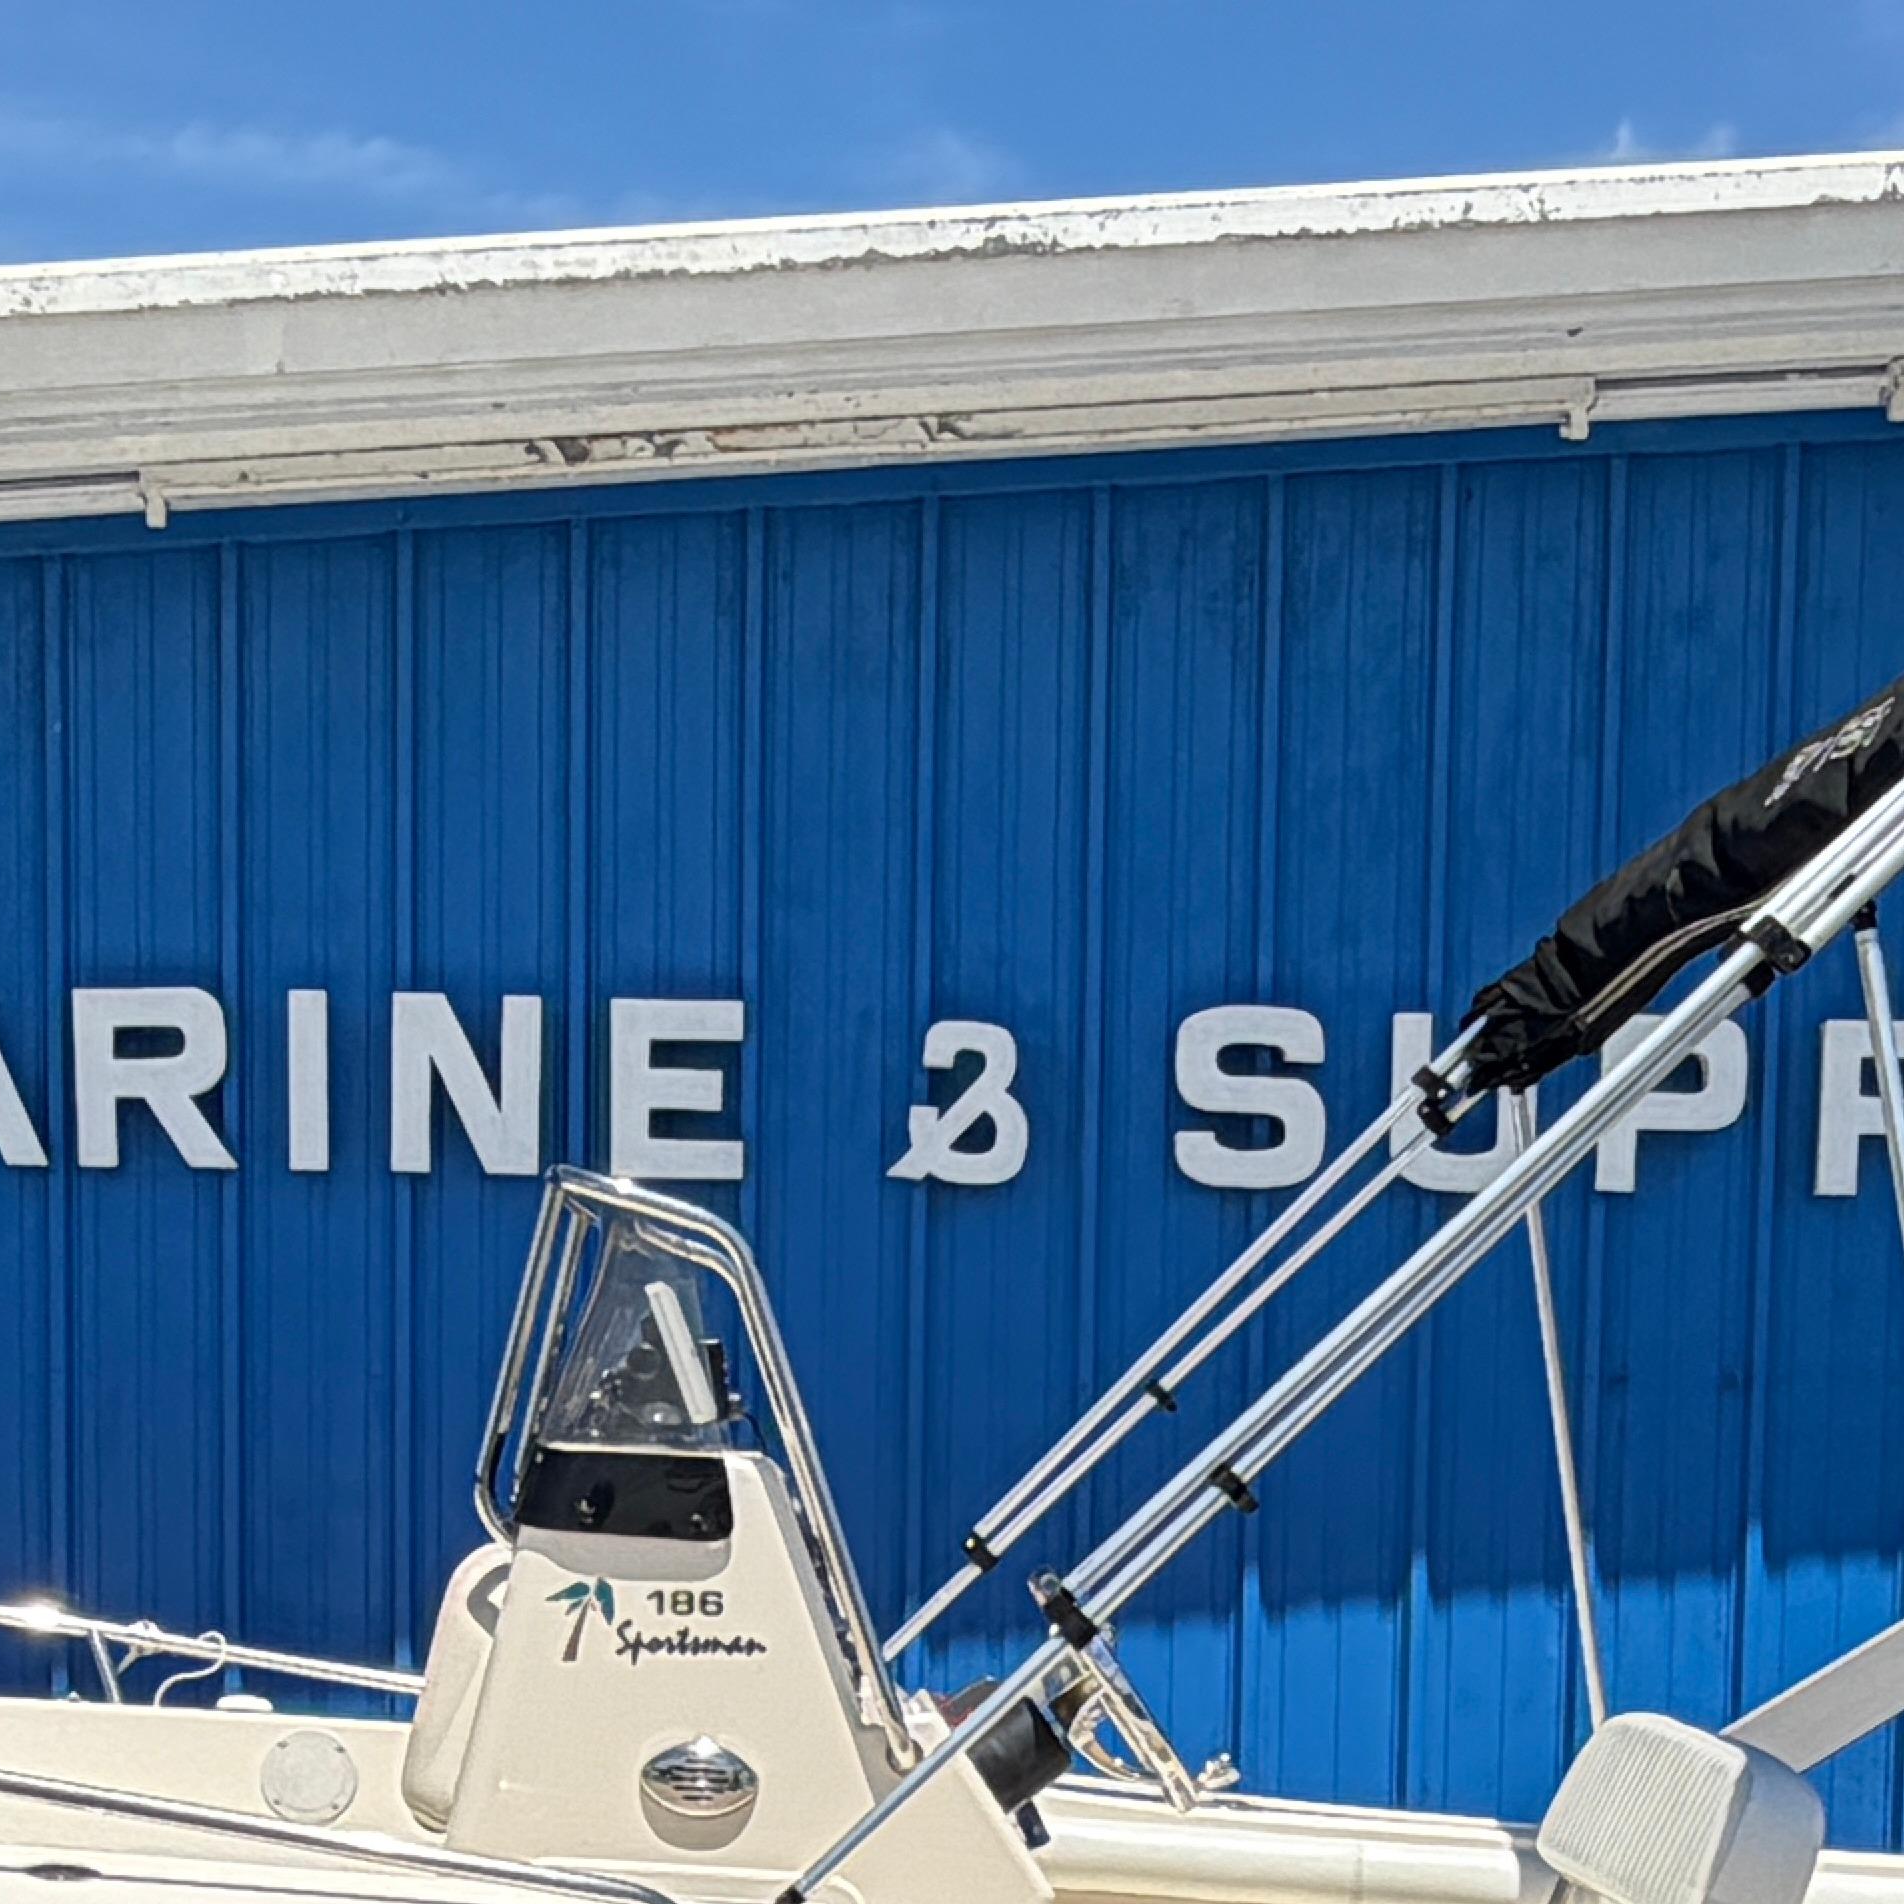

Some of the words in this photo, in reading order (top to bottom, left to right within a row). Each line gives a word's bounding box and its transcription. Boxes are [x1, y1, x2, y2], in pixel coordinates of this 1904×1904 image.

[886, 1020, 1028, 1185] &
[647, 1590, 724, 1617] 186
[615, 1618, 767, 1666] Sportsman
